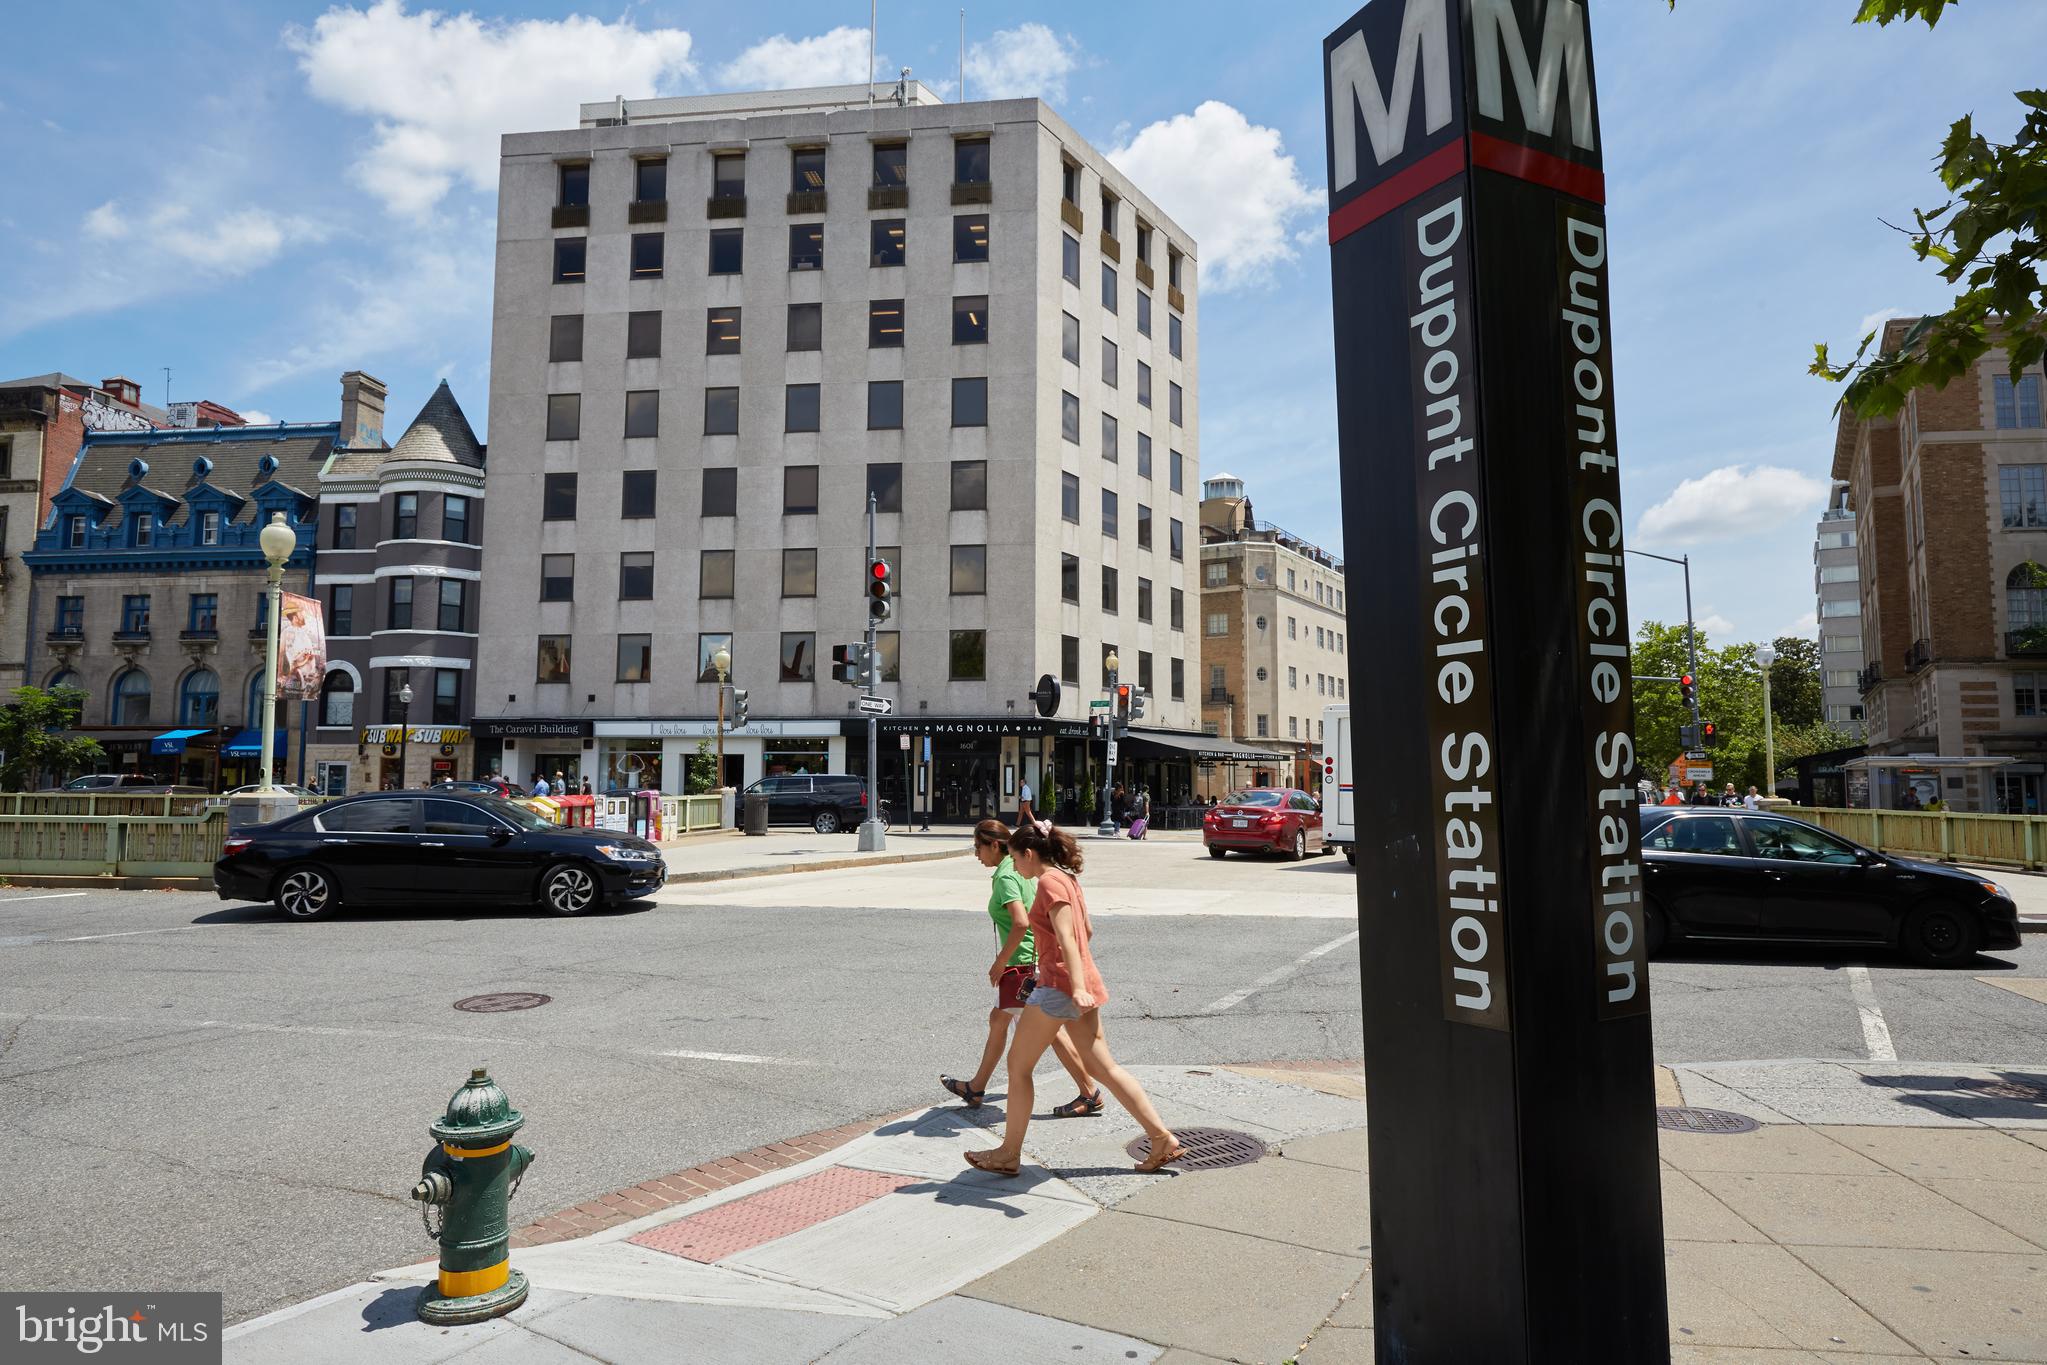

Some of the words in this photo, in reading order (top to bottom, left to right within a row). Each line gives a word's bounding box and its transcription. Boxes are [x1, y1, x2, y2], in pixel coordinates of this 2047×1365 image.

[1330, 0, 1452, 192] M
[1470, 0, 1594, 151] M
[1411, 196, 1474, 471] Dupont
[1562, 217, 1617, 474] Dupont
[1428, 490, 1484, 704] Circle
[1583, 498, 1627, 703] Circle
[368, 728, 415, 744] SUBWAY
[414, 728, 470, 744] SUBWAY
[489, 725, 504, 734] The
[505, 725, 537, 734] Caravel
[539, 724, 579, 735] Building
[936, 724, 1009, 733] MAGNOLIA
[1441, 731, 1499, 1011] Station
[1595, 730, 1641, 1003] Station
